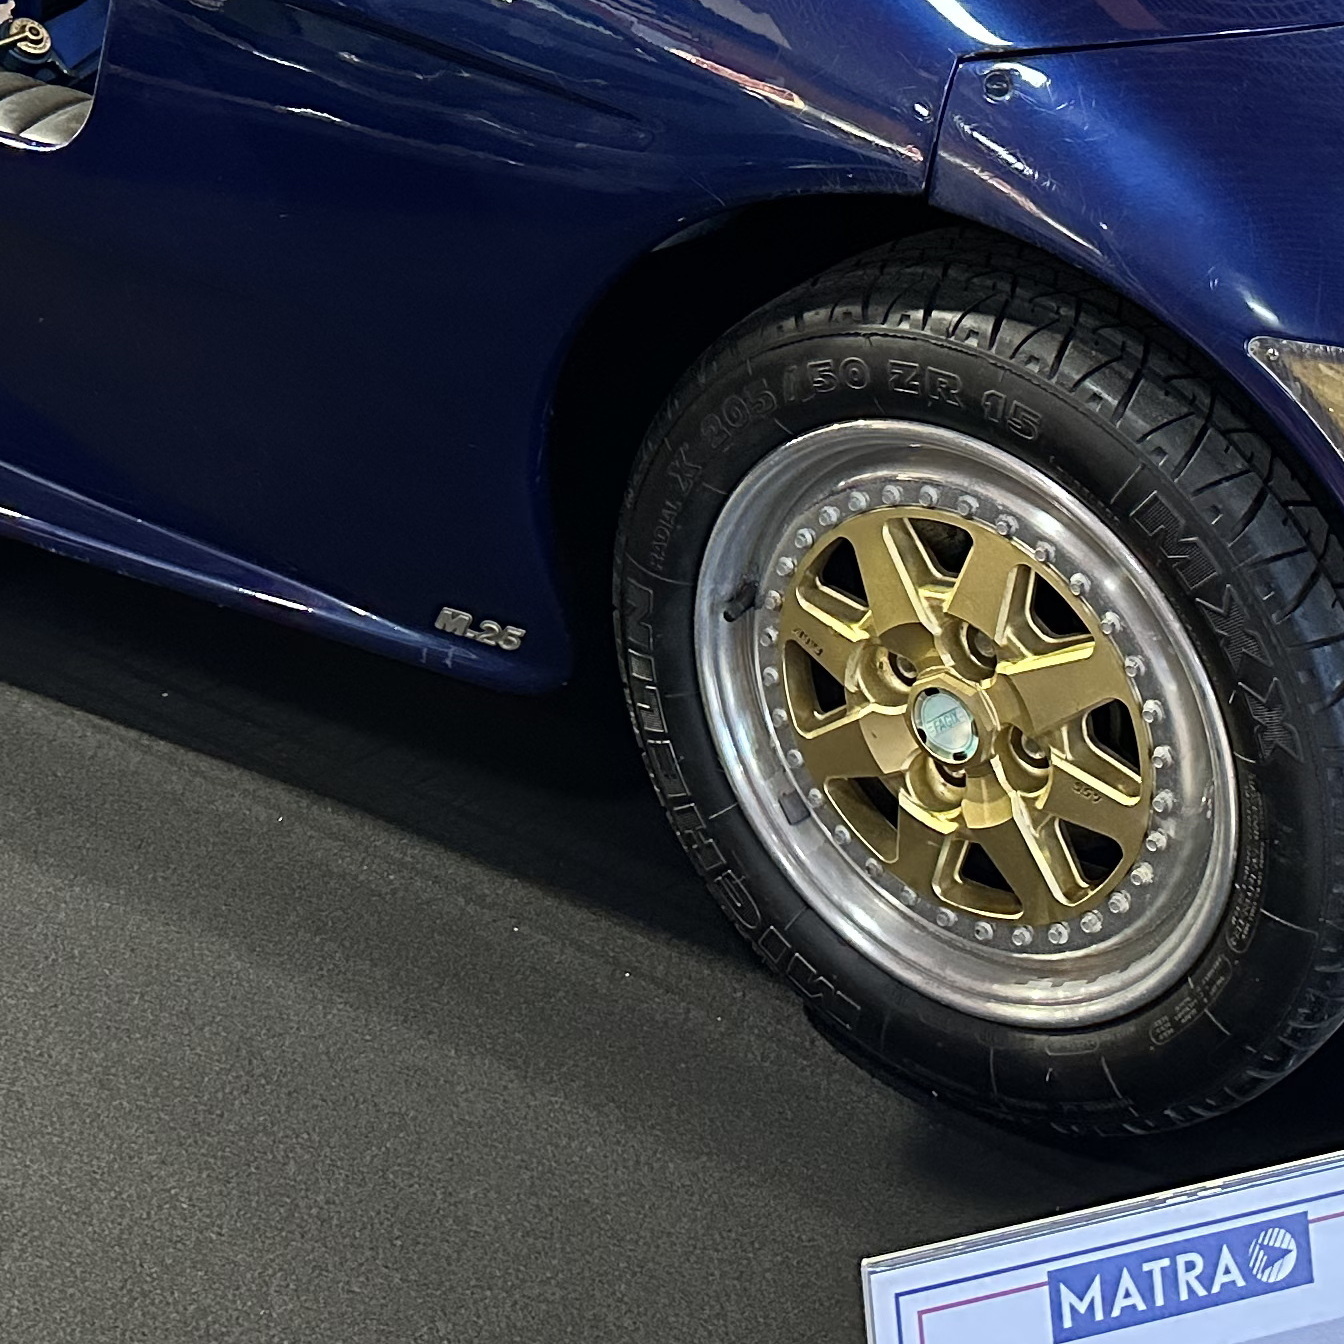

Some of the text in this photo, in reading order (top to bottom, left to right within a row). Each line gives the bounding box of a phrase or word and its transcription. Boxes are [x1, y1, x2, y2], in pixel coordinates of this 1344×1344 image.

[887, 358, 964, 408] ZR
[981, 389, 1044, 441] 15
[1128, 488, 1305, 764] MXX
[623, 574, 864, 1031] MICHELIN
[1058, 1243, 1248, 1330] MATRA
